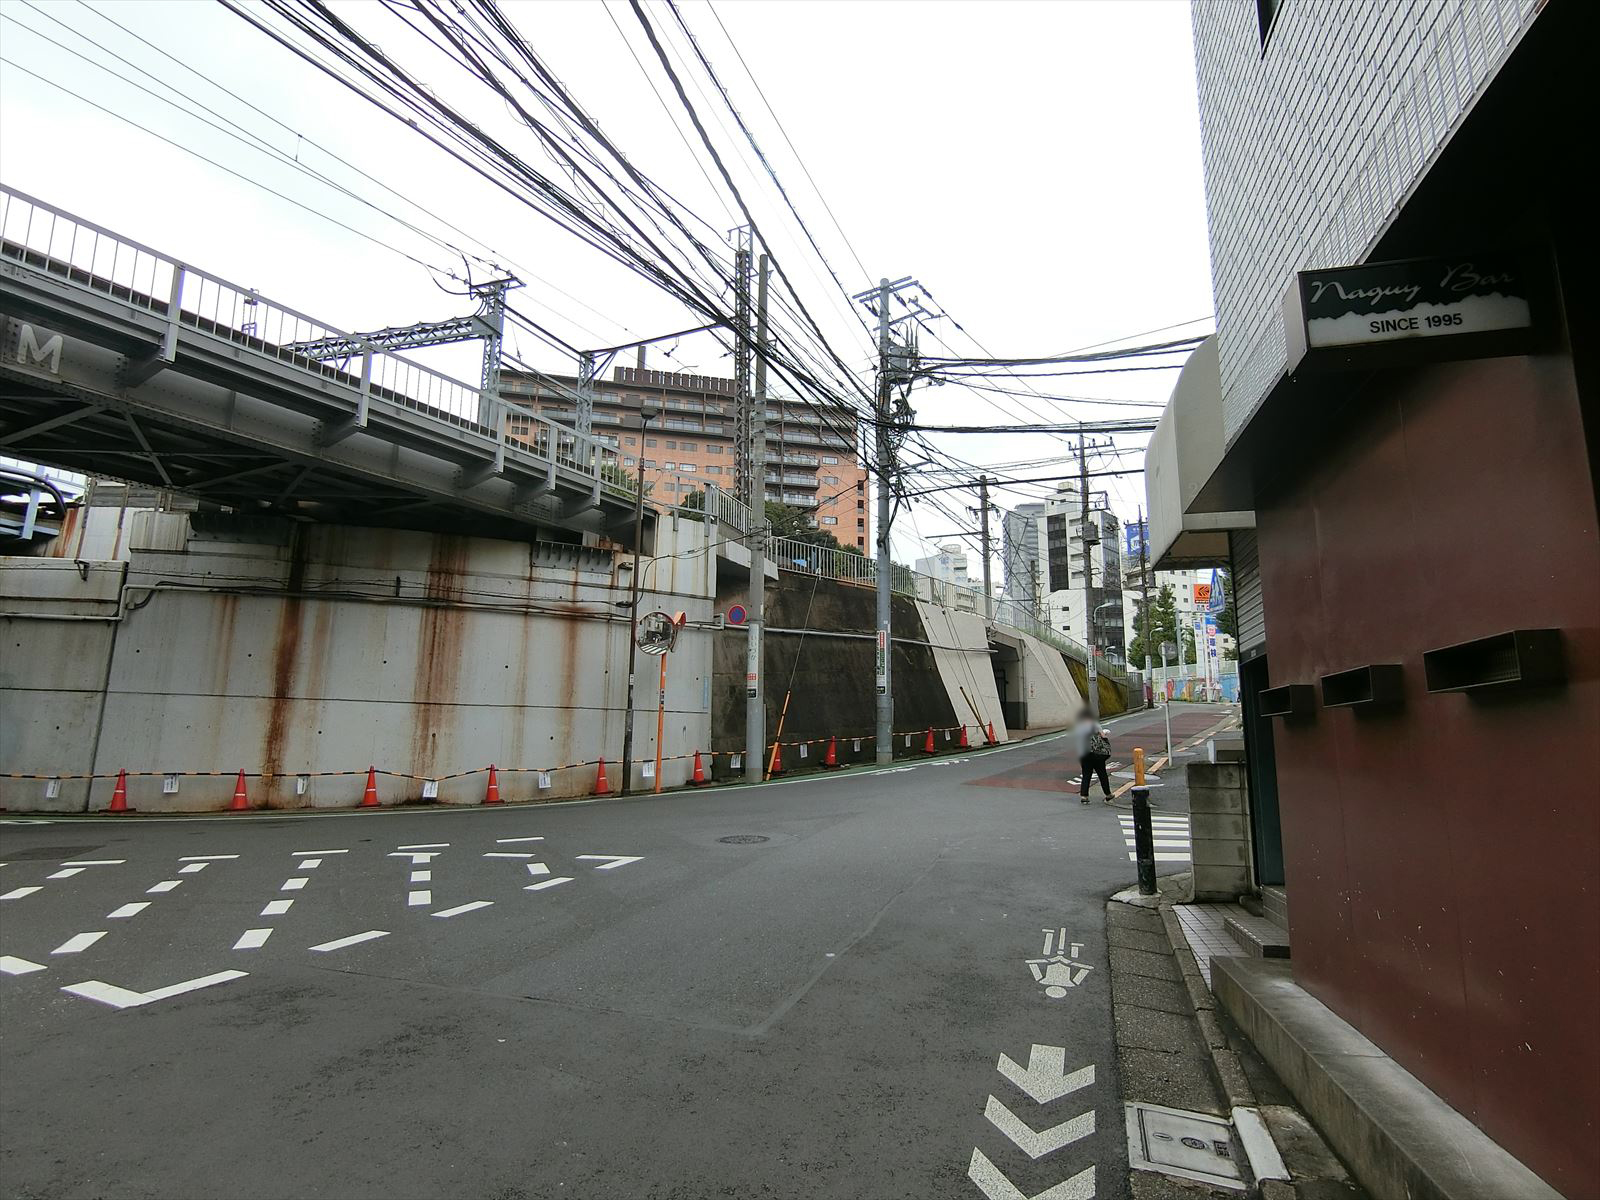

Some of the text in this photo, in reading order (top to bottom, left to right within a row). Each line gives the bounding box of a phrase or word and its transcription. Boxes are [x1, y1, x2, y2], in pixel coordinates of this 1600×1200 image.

[1310, 263, 1515, 306] Naguy Bar
[1369, 313, 1463, 334] SINCE 1995
[17, 324, 63, 374] M
